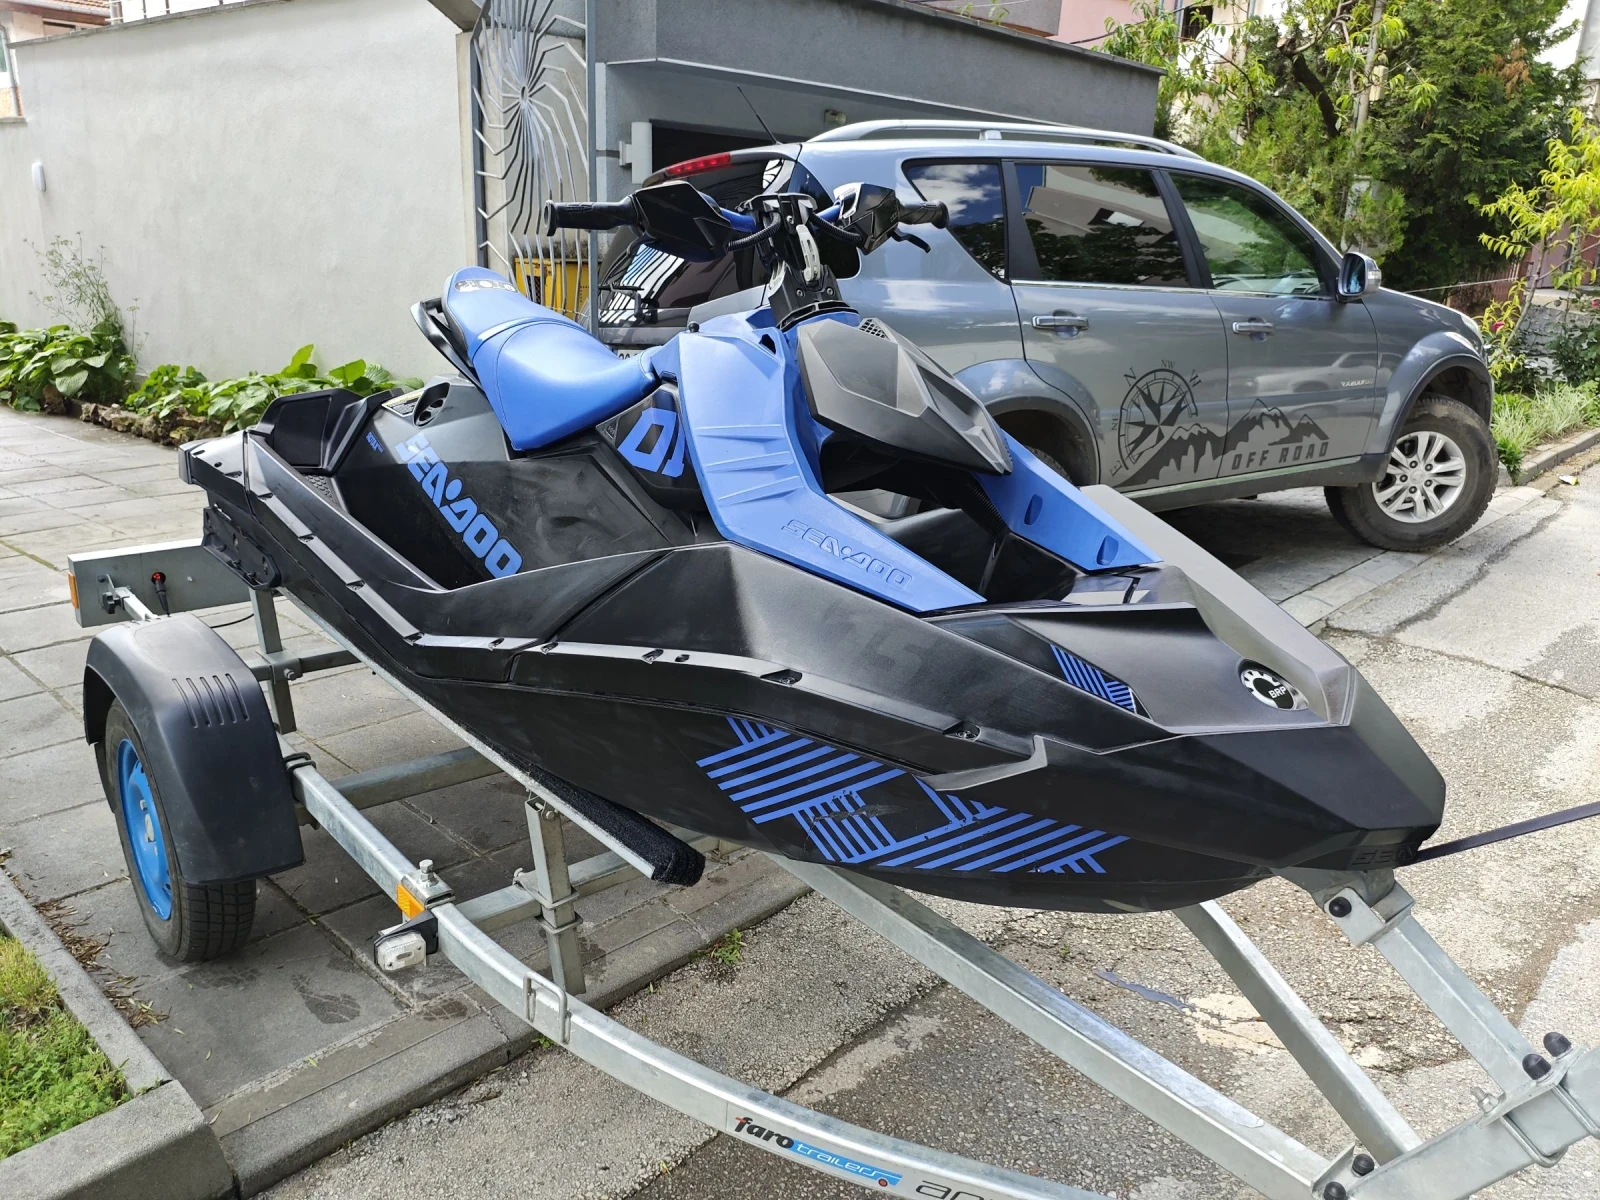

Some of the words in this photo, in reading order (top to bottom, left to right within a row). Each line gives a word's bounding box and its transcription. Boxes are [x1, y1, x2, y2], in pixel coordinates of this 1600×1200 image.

[1123, 367, 1137, 387] N
[1231, 453, 1270, 470] OFF
[1278, 441, 1329, 464] ROAD
[1109, 460, 1123, 477] E
[1268, 685, 1287, 699] BRP
[735, 1116, 795, 1149] faro
[797, 1143, 888, 1178] trailers
